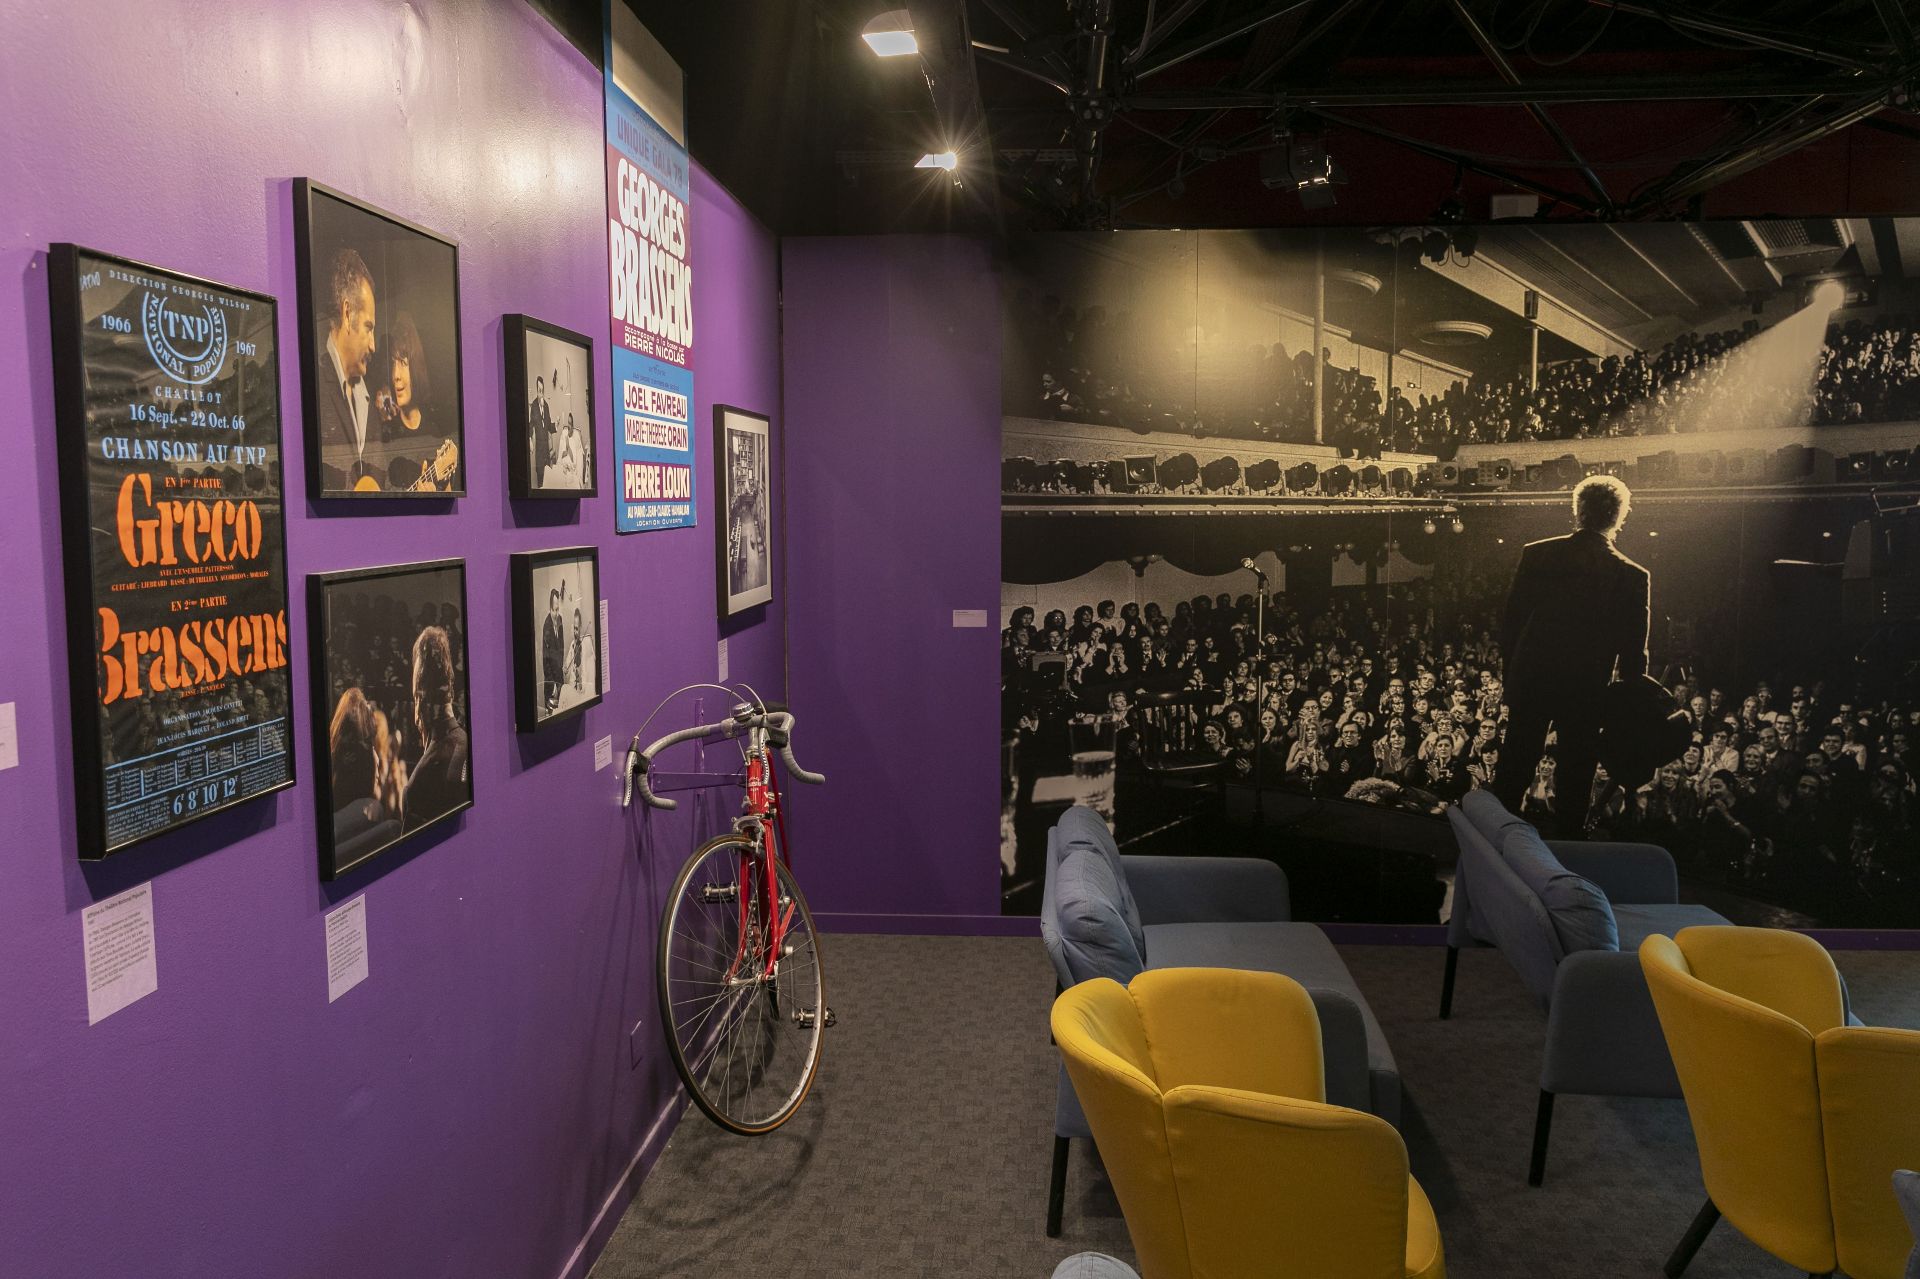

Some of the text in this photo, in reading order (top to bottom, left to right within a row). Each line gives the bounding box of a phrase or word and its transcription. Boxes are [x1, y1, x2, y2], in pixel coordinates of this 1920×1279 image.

[618, 158, 685, 260] GEORGES
[109, 270, 167, 291] DIRECTION
[172, 285, 215, 302] GEORGES
[219, 297, 250, 311] WILSON
[611, 218, 693, 348] BRASSENS
[101, 314, 132, 333] 1966
[149, 293, 223, 377] NATIONAL POPULAIRE
[164, 310, 209, 343] TNP
[235, 340, 256, 356] 1967
[624, 332, 685, 365] PIERRE NICOLAS
[155, 385, 222, 404] CHAILLOT
[625, 385, 687, 419] JOEL FAVREAU
[129, 404, 146, 421] 16
[148, 405, 178, 429] Sept.
[190, 410, 206, 427] 22
[208, 412, 230, 429] Oct.
[232, 414, 246, 431] 66
[101, 436, 267, 465] CHANSON AU TNP
[667, 426, 688, 448] ORAIN
[165, 476, 176, 488] EN
[193, 477, 222, 489] PARTIE
[624, 464, 690, 499] PIERRE LOUKI
[117, 473, 263, 568] Greco
[636, 519, 661, 527] LOCATION
[171, 601, 182, 612] EN
[199, 595, 228, 609] PARTIE
